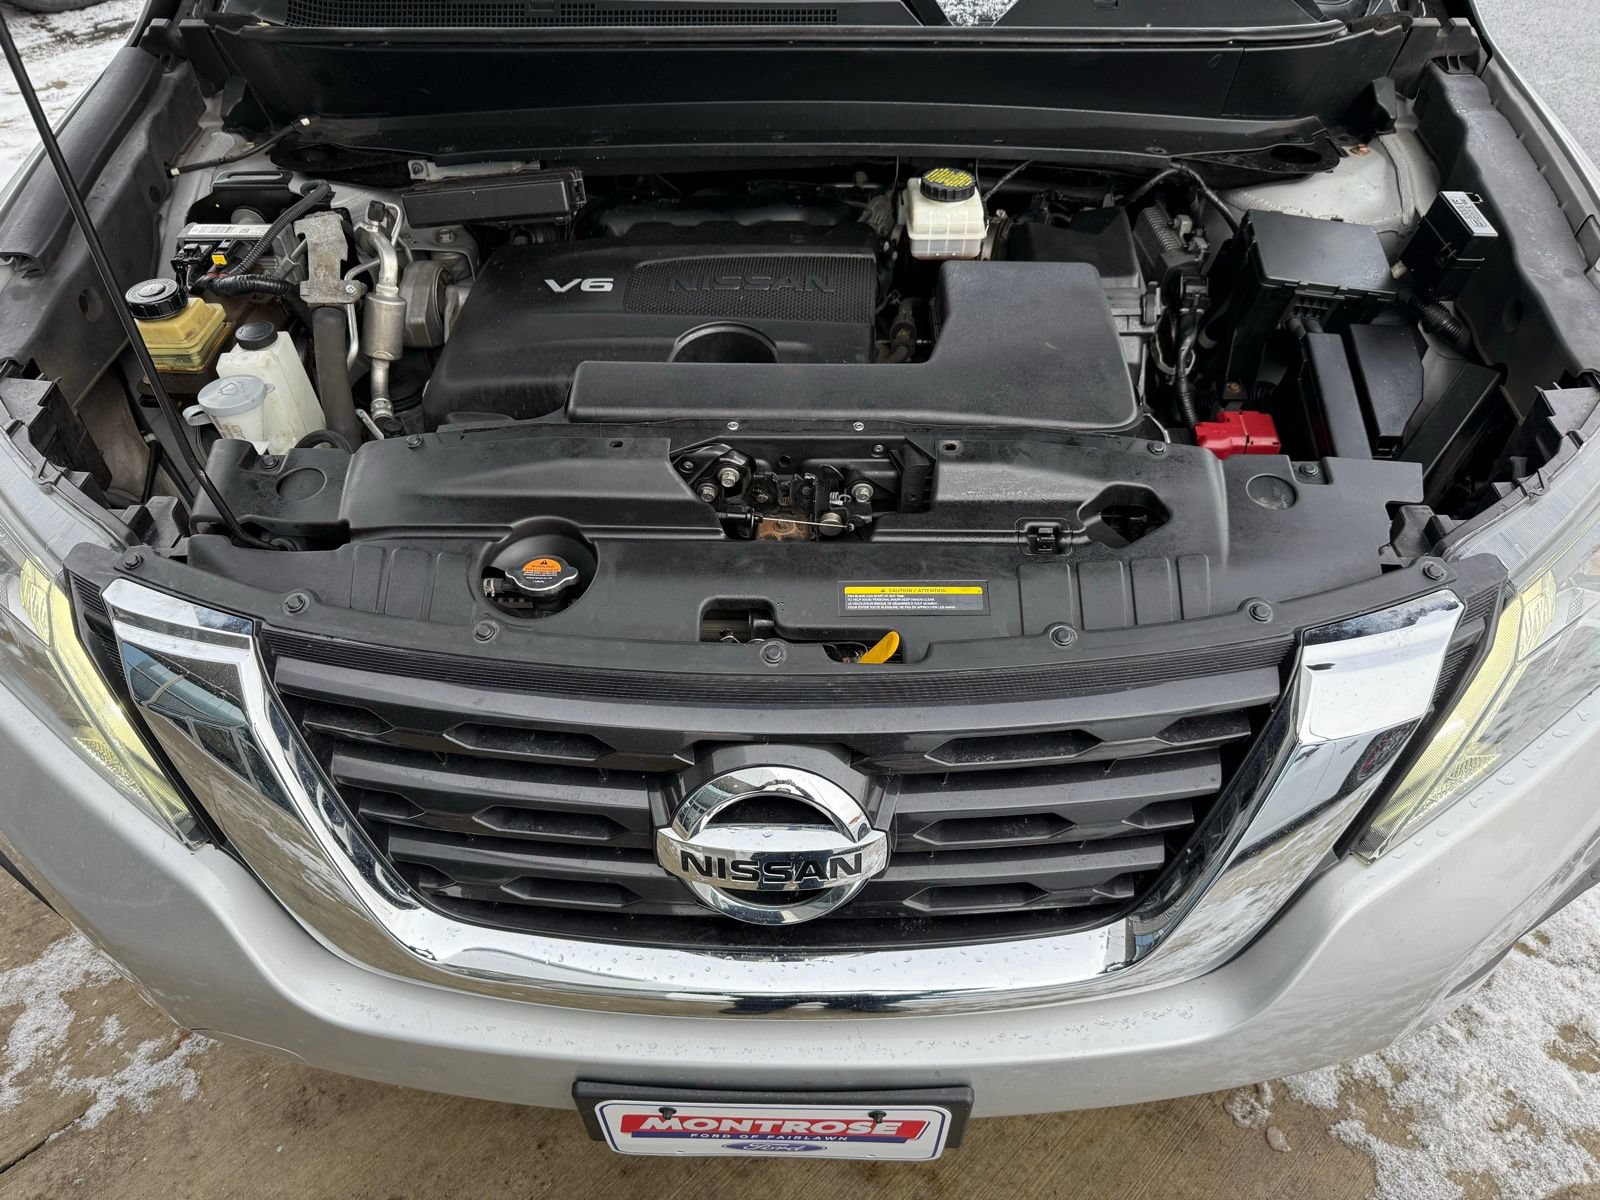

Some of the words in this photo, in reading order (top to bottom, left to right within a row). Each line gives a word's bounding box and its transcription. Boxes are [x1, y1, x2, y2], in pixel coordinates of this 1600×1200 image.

[544, 278, 614, 293] V6
[672, 275, 835, 293] NISSAN
[680, 850, 863, 883] NISSAN
[639, 1117, 902, 1135] MONTROSE
[743, 1142, 805, 1151] Ford
